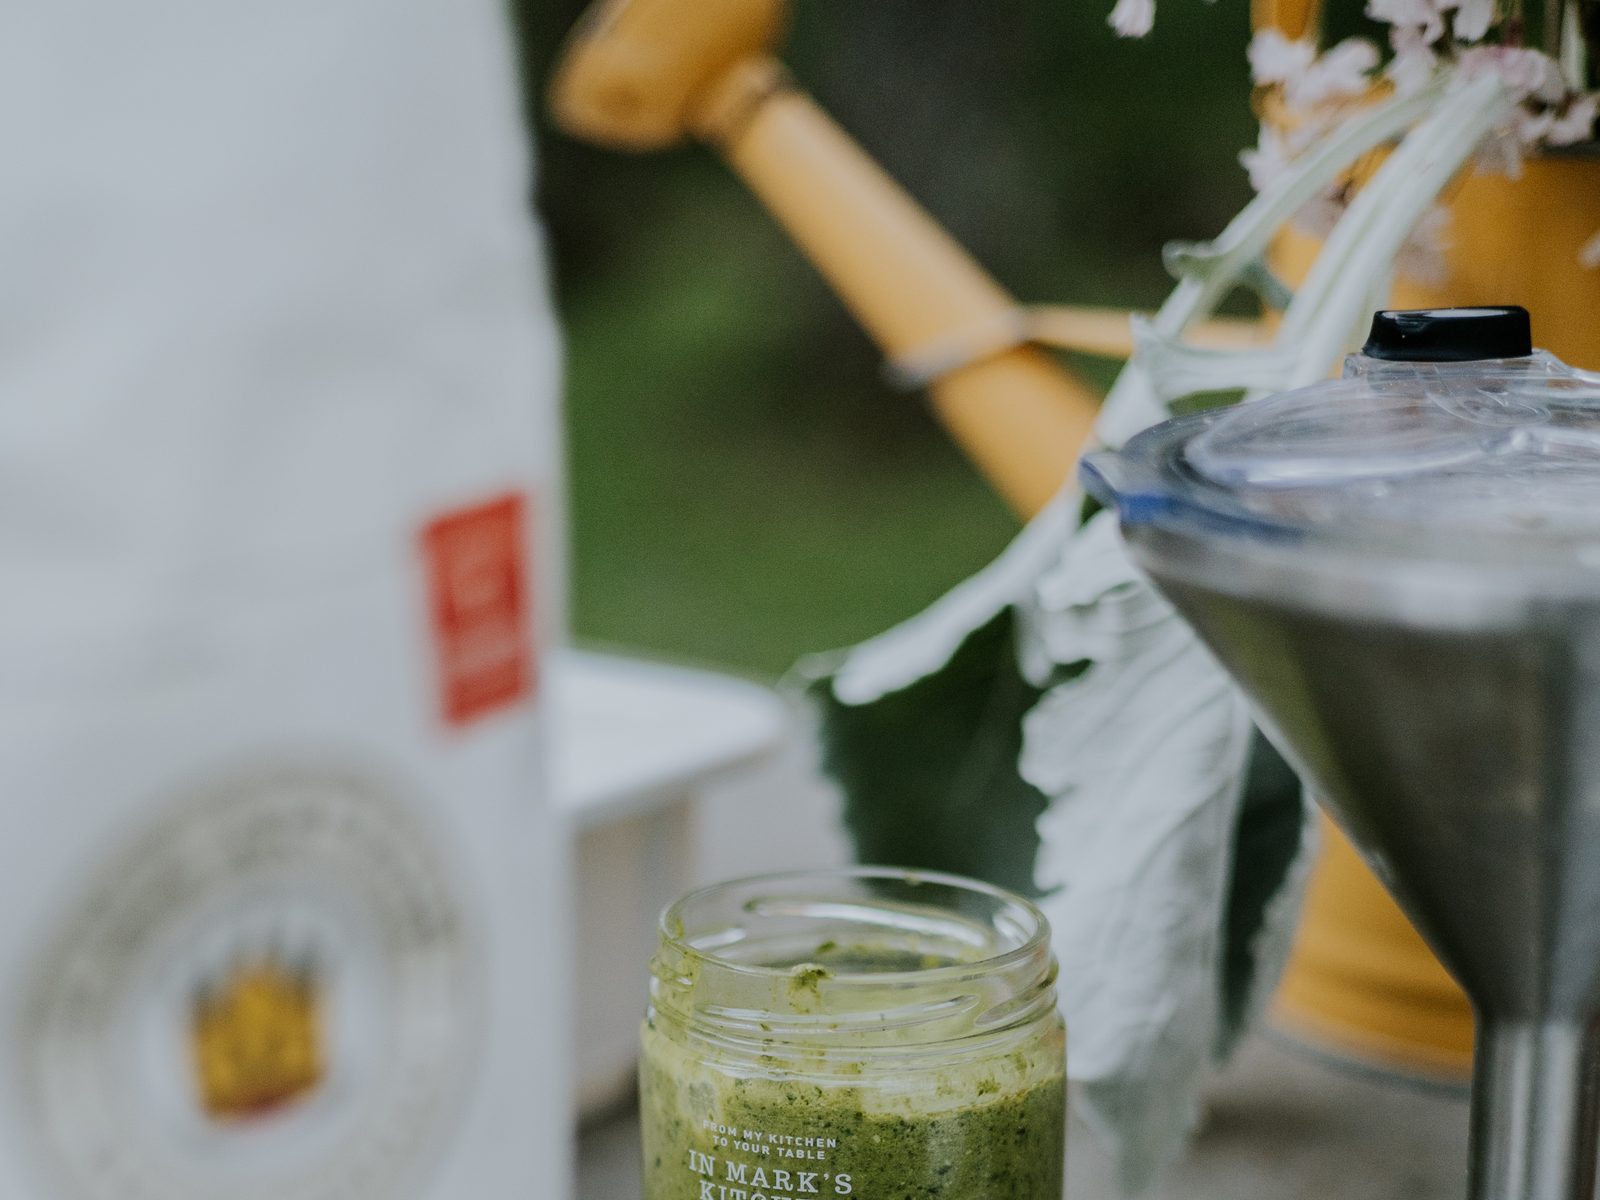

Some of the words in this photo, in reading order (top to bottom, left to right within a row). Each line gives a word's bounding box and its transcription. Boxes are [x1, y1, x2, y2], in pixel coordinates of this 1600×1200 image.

[703, 1120, 737, 1136] FROM
[743, 1130, 763, 1142] MY
[769, 1134, 837, 1148] KITCHEN
[712, 1135, 727, 1147] TO
[734, 1140, 770, 1155] YOUR
[777, 1147, 826, 1160] TABLE
[688, 1149, 715, 1176] IN
[726, 1161, 852, 1194] MARK'S
